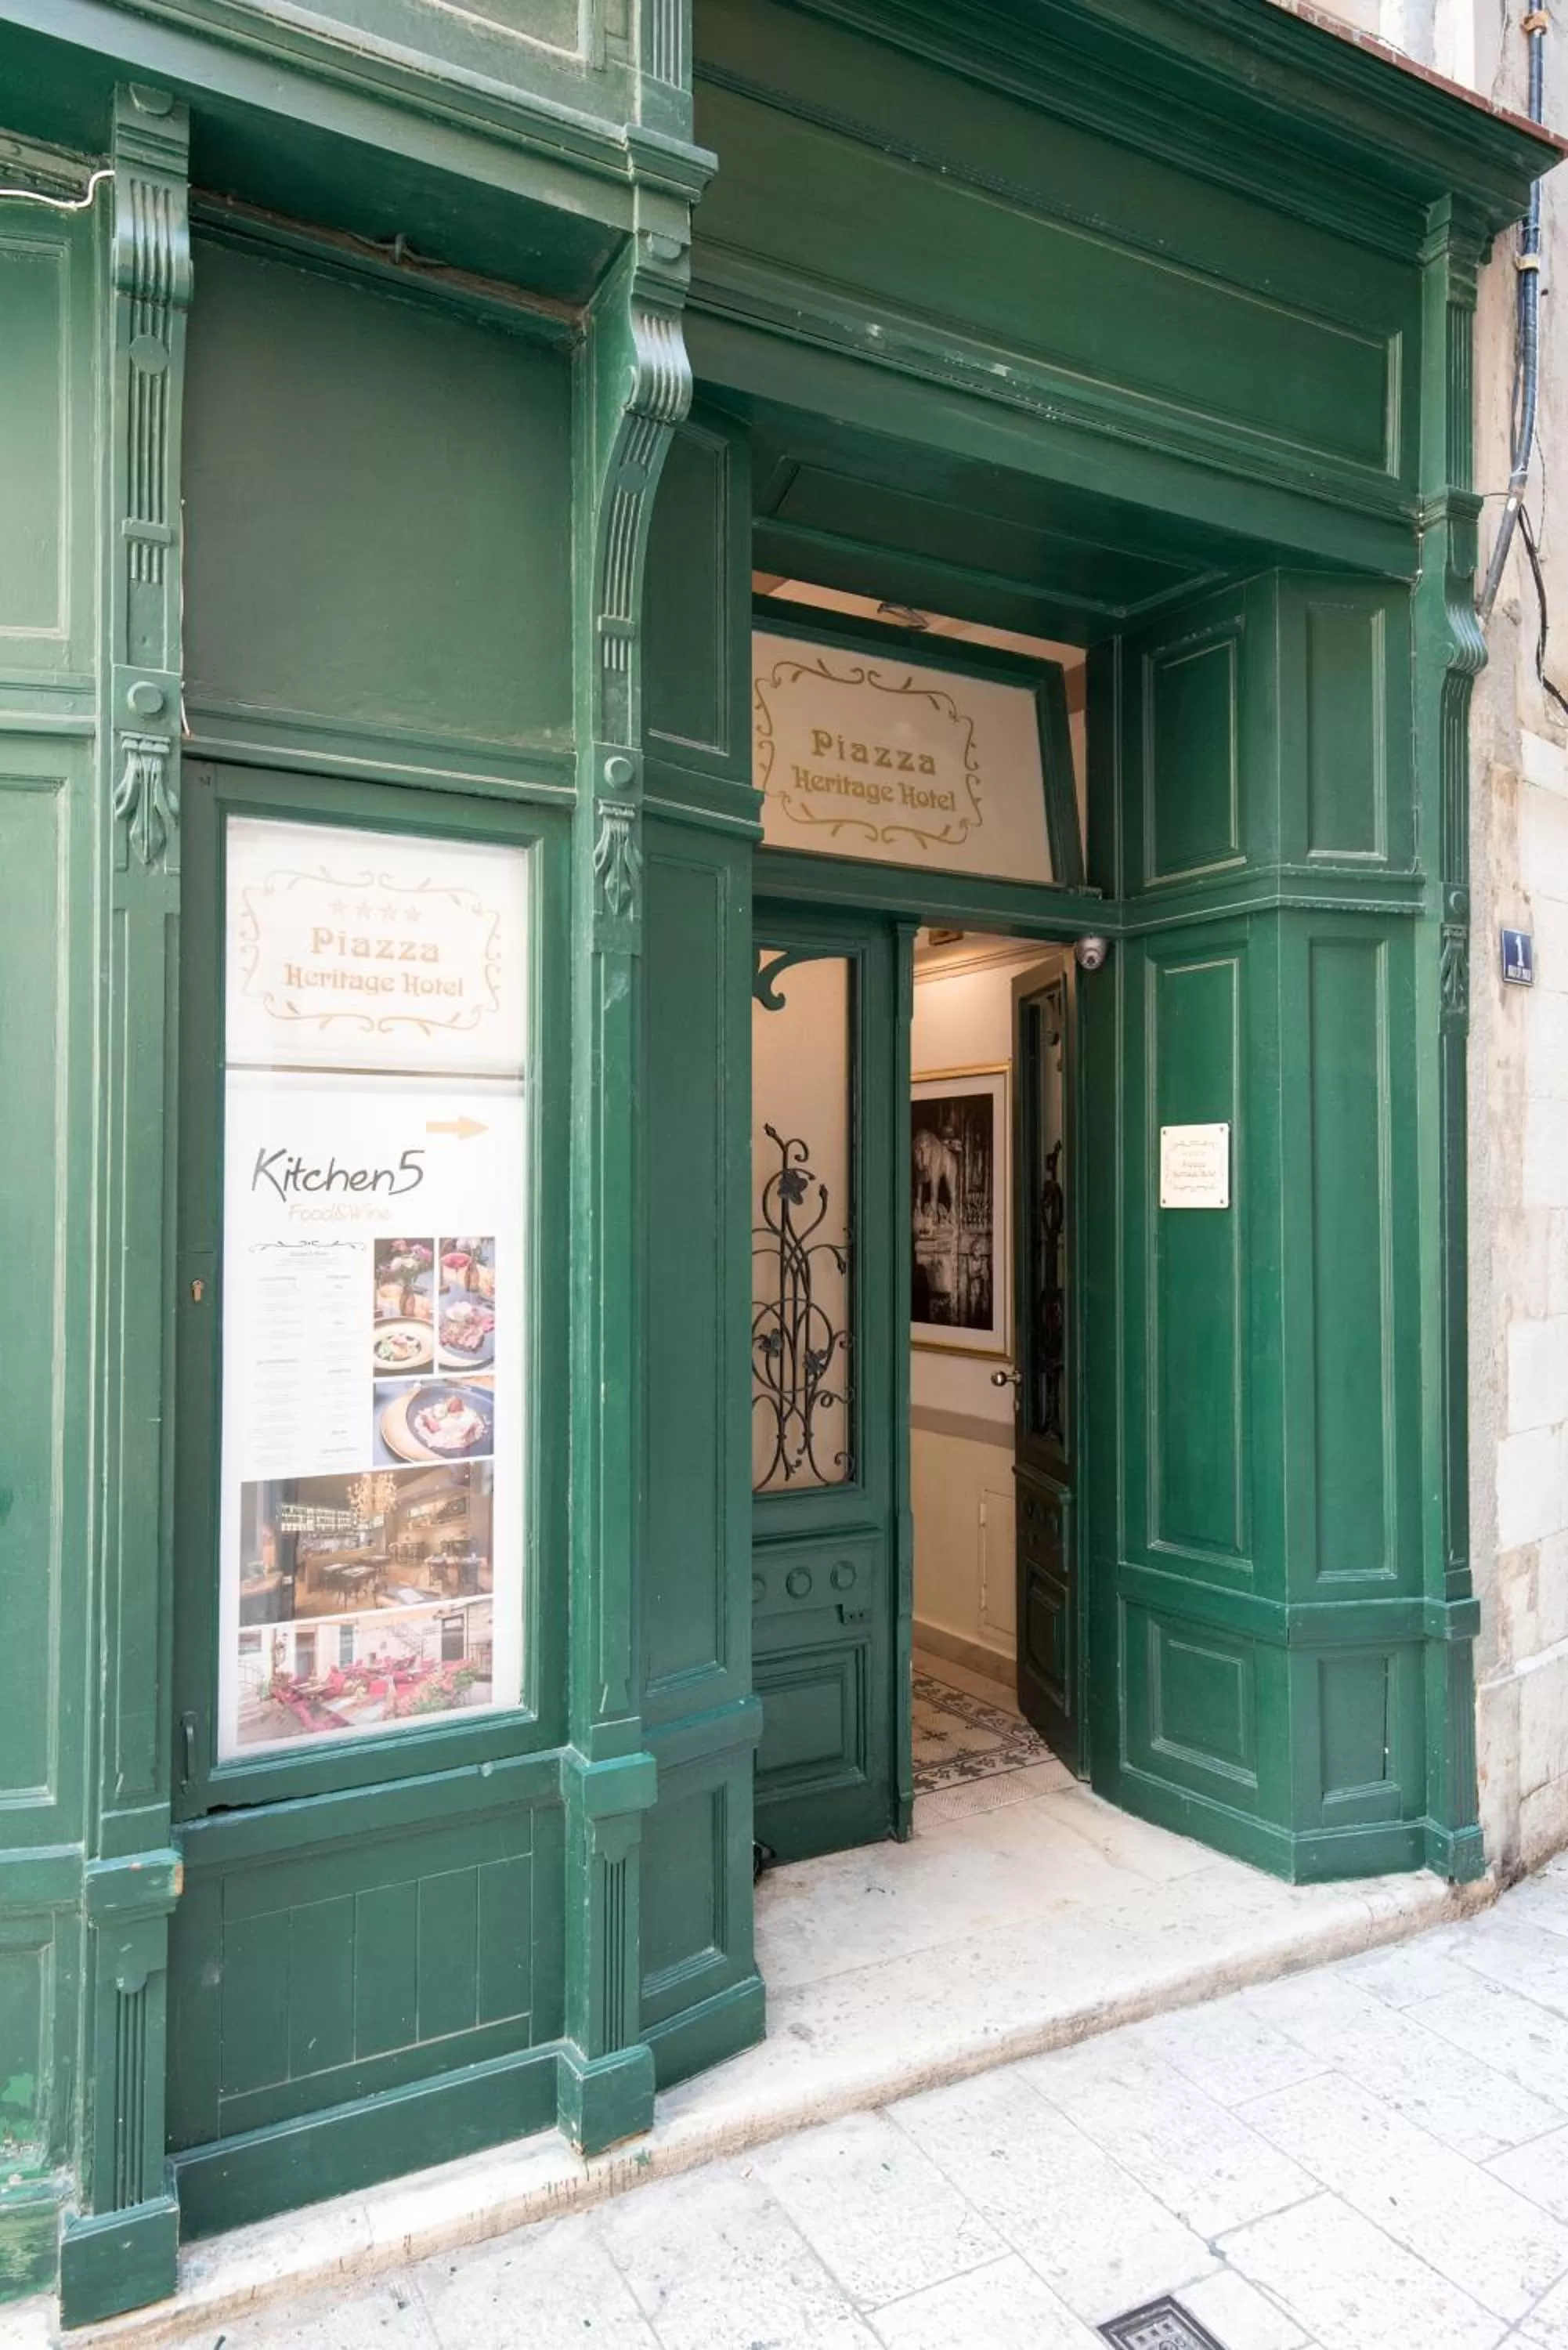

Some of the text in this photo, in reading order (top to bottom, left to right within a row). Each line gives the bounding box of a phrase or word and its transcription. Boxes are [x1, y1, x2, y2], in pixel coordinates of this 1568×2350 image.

[811, 729, 936, 775] Piazza
[791, 765, 956, 812] Heritage Hotel
[310, 927, 440, 963] Piazza
[1516, 935, 1524, 967] 1
[284, 963, 464, 997] Heritage Hotel
